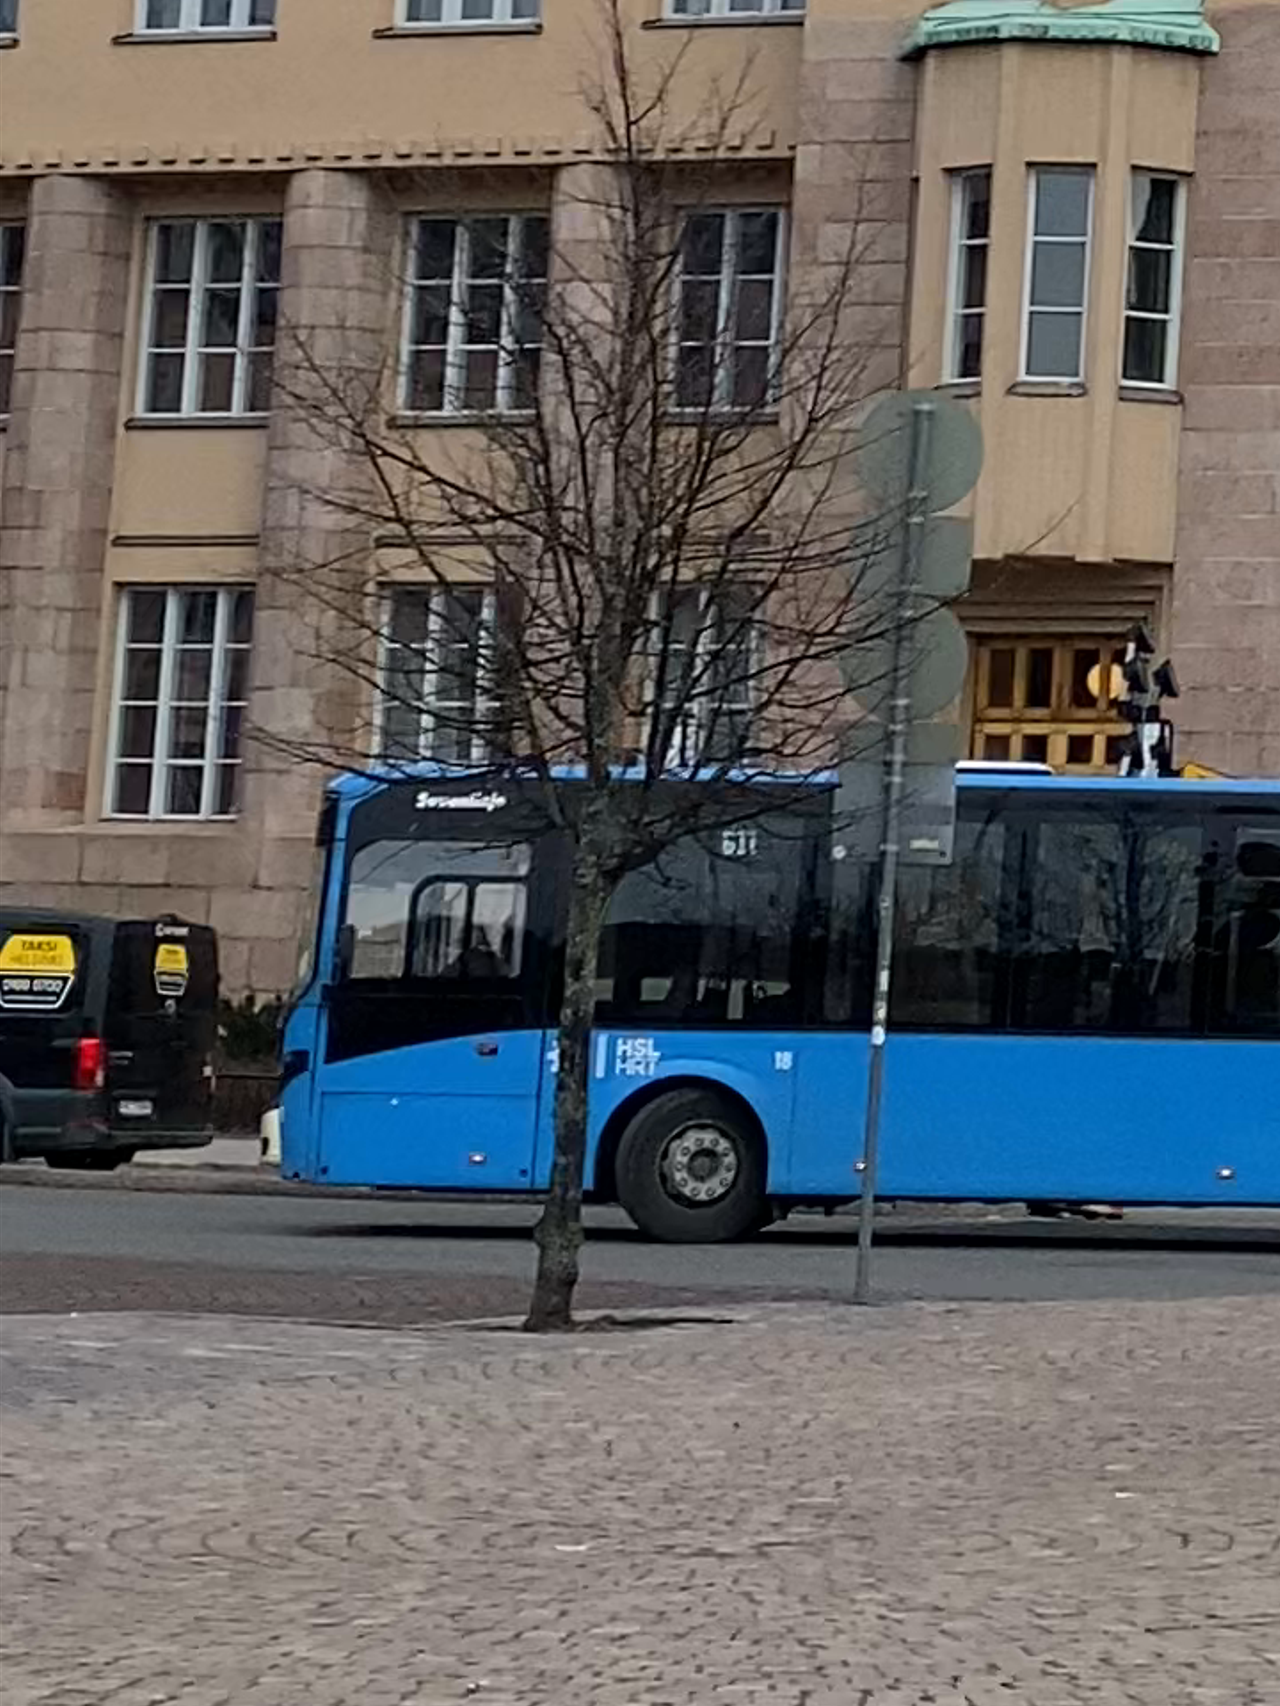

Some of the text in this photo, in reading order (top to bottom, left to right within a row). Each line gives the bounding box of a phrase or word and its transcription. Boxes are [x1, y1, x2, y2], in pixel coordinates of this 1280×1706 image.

[21, 940, 58, 952] TAKSI
[616, 1037, 661, 1059] HSL
[614, 1056, 661, 1076] HRT
